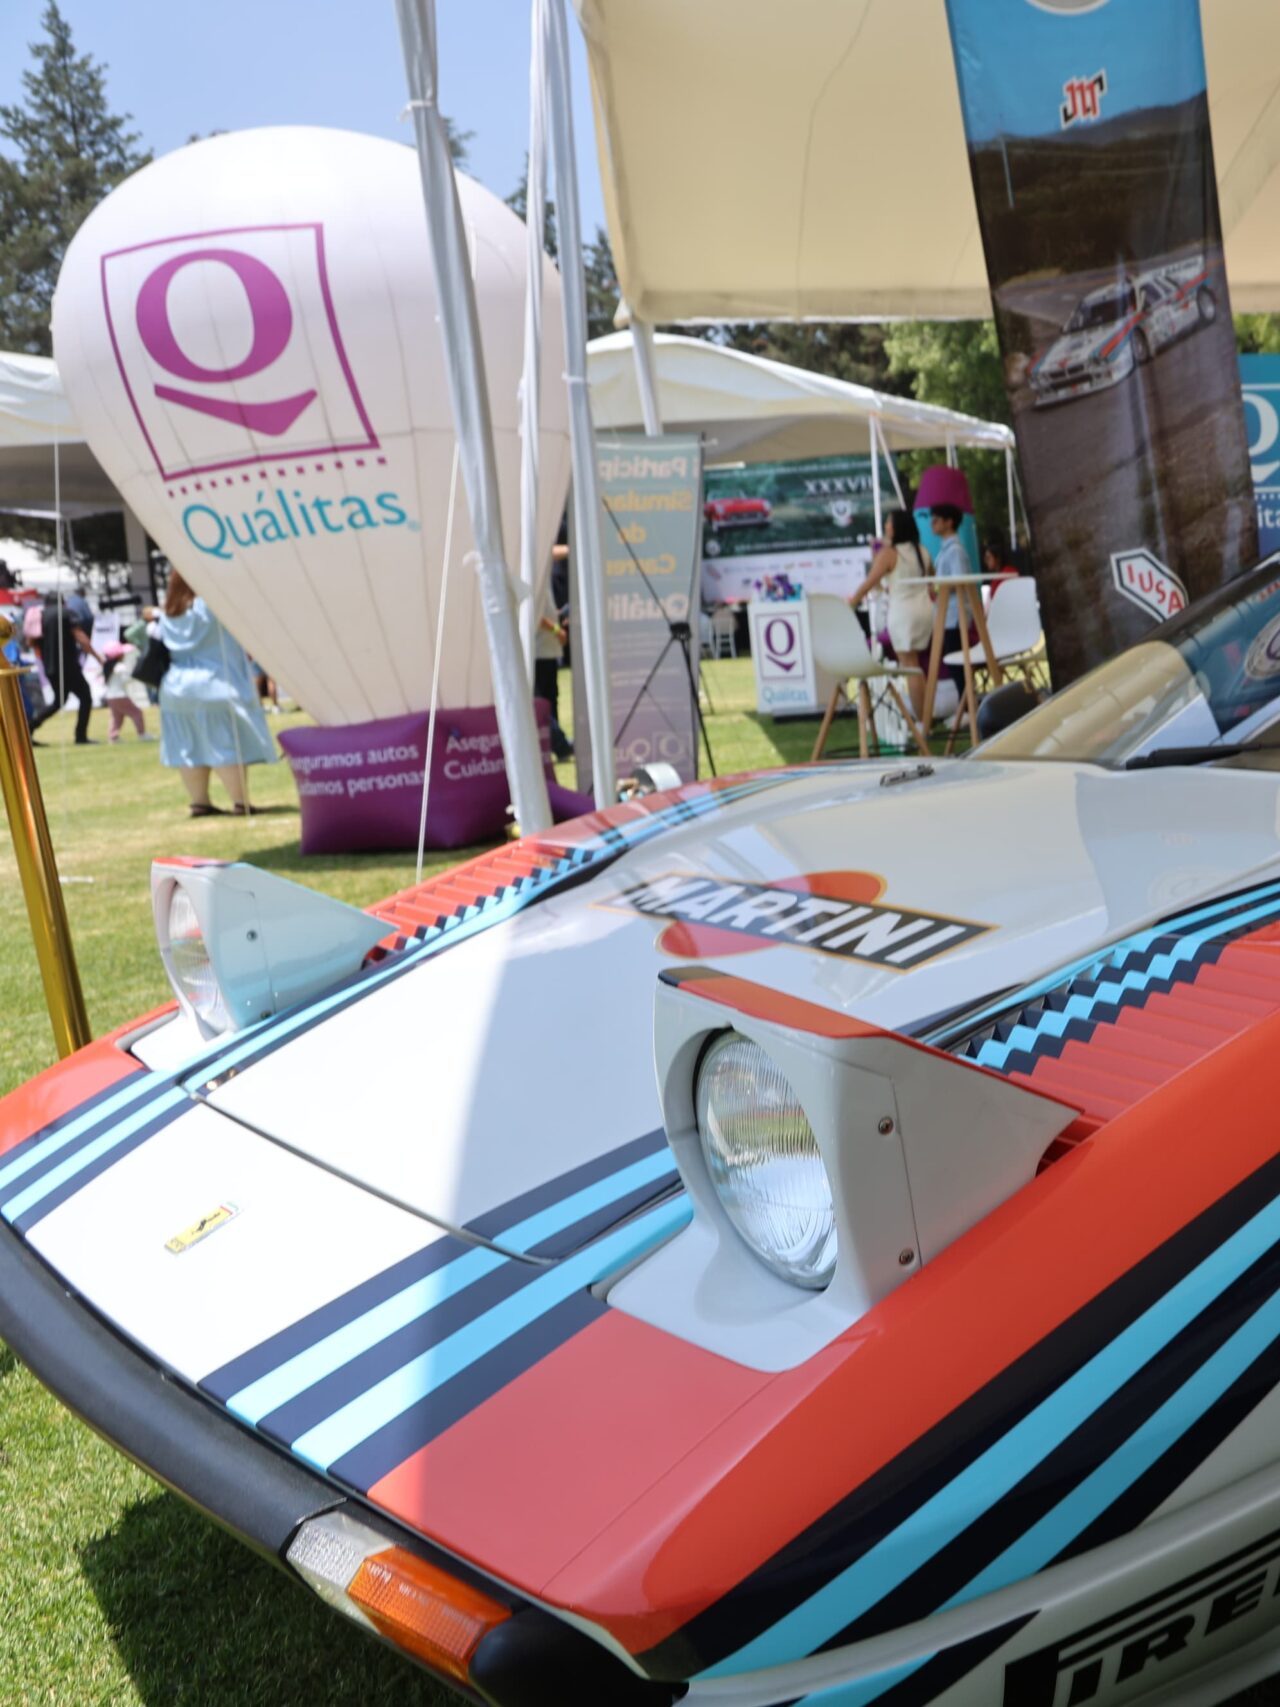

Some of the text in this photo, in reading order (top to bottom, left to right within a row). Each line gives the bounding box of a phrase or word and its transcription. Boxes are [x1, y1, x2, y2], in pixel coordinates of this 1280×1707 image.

[182, 488, 407, 560] Quálitas
[1127, 563, 1184, 615] IUSA
[368, 744, 419, 765] autos
[610, 875, 967, 964] MARTINI
